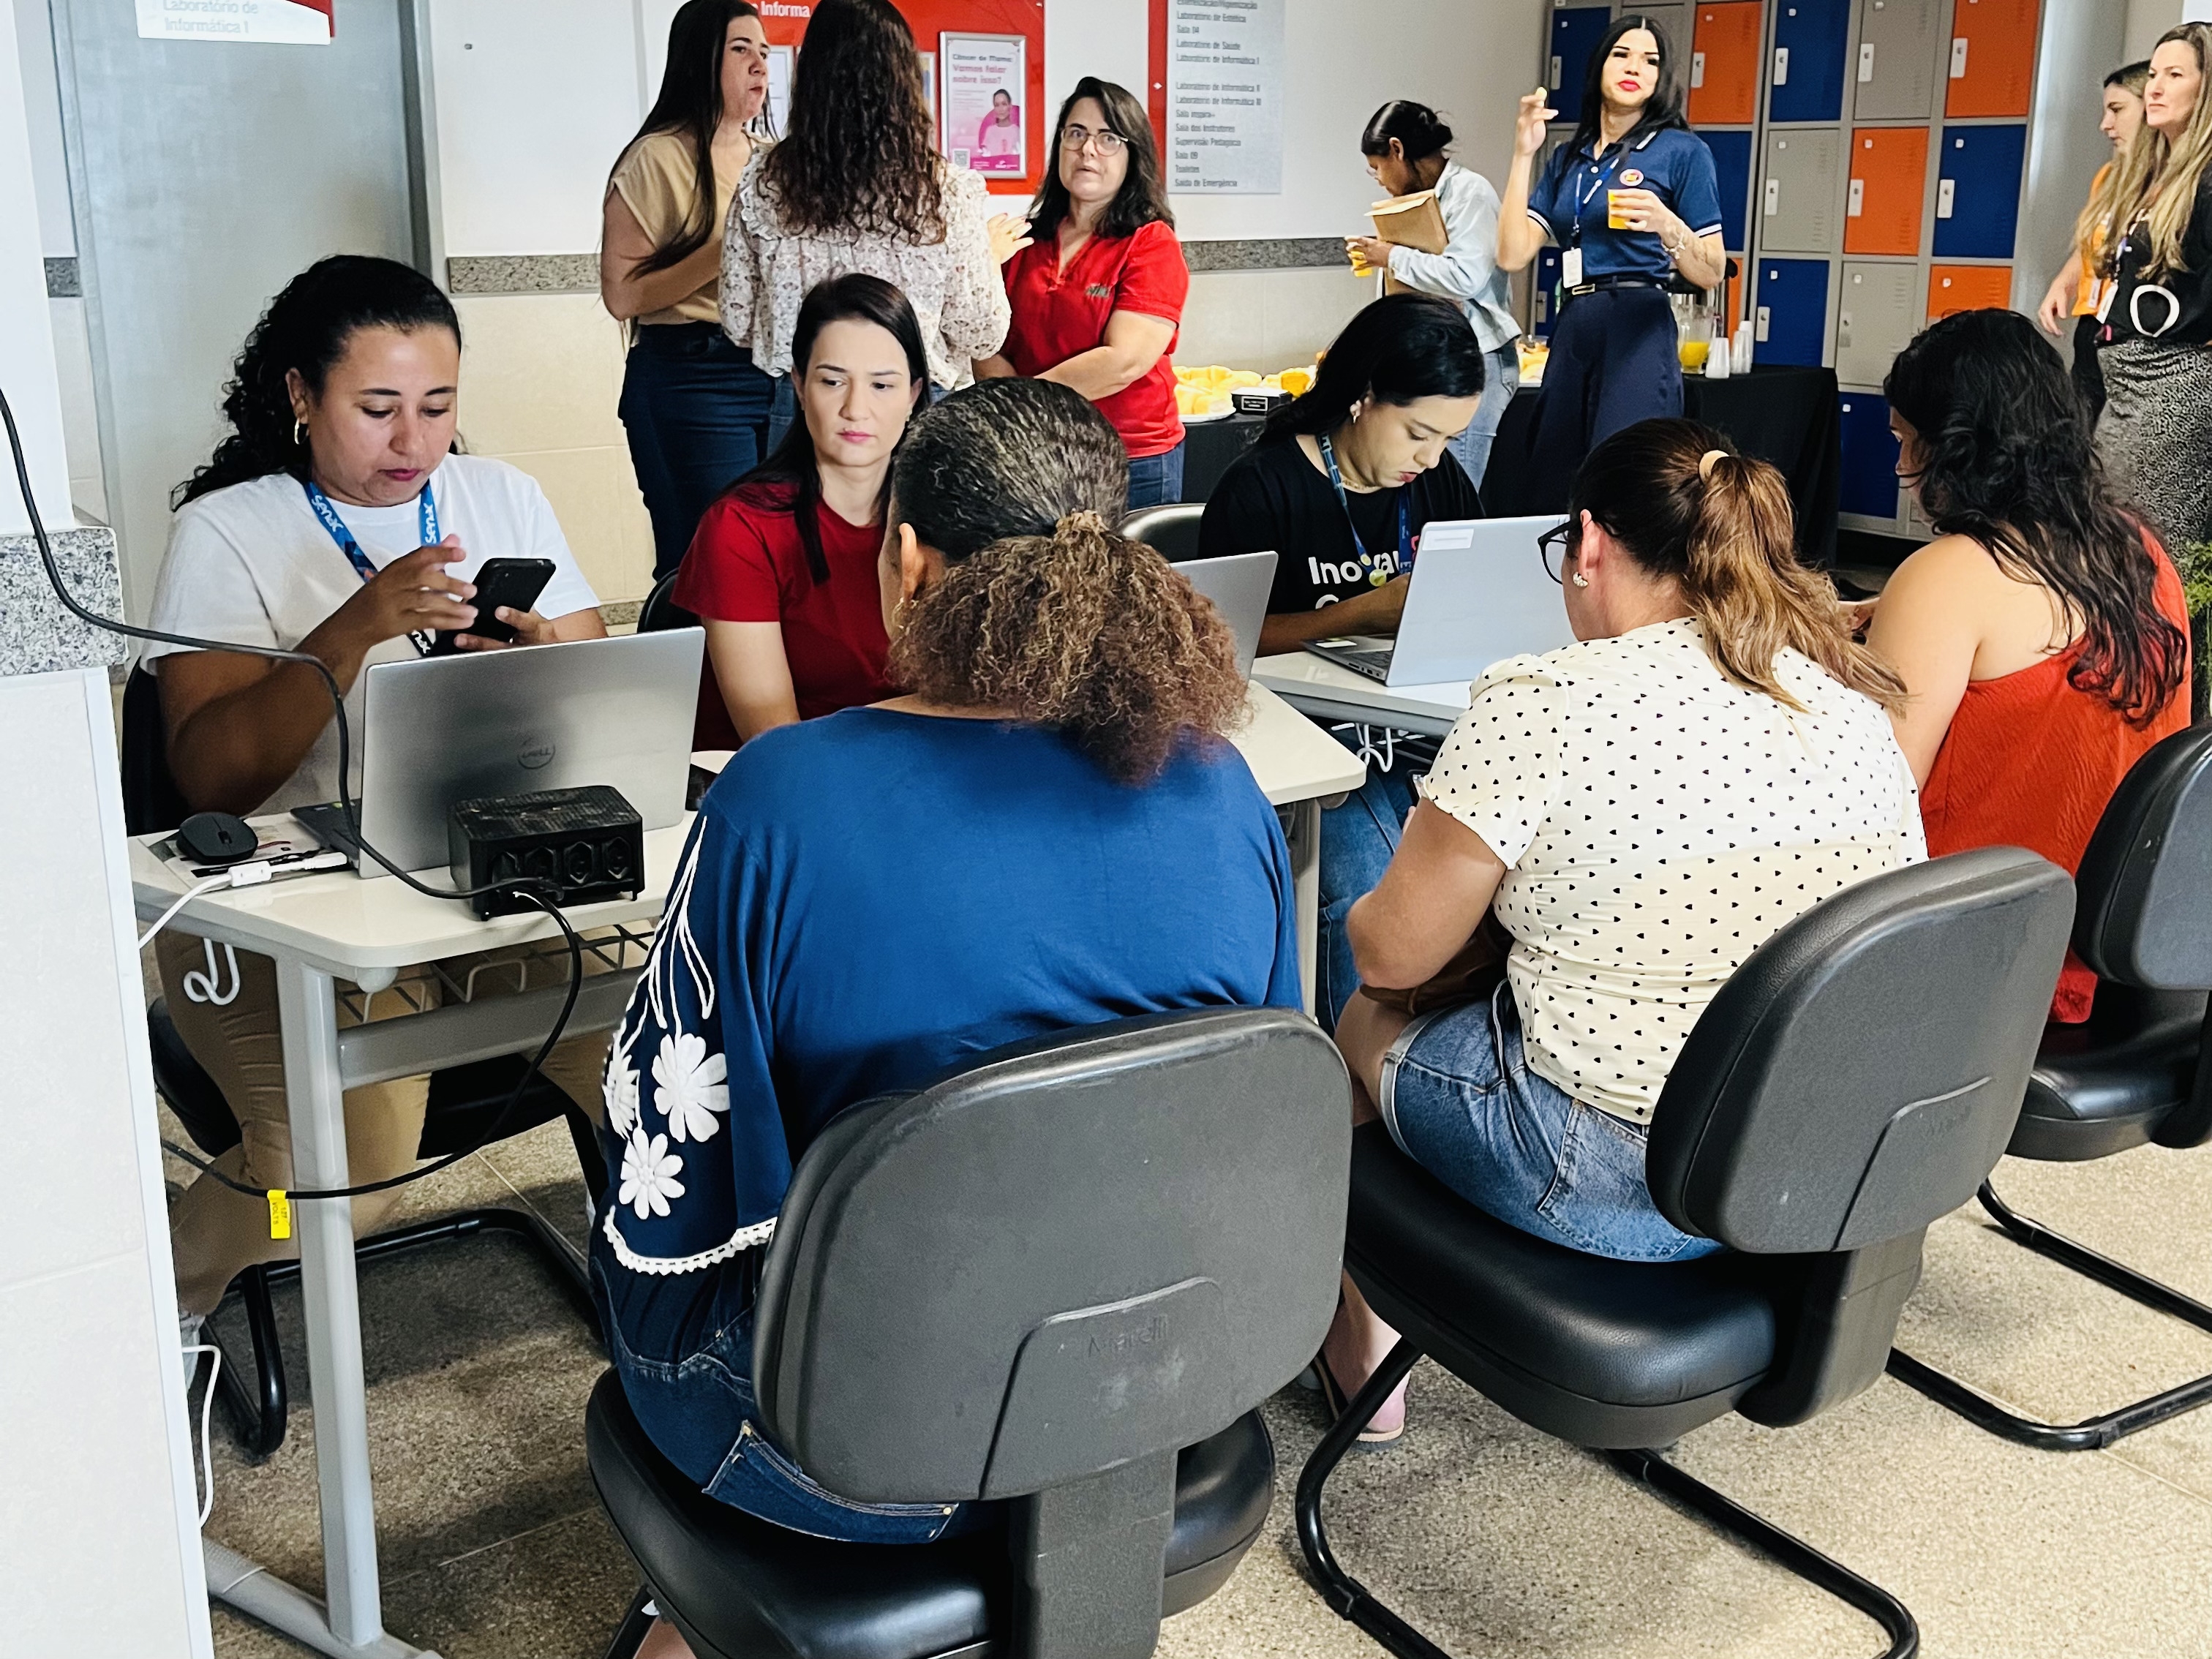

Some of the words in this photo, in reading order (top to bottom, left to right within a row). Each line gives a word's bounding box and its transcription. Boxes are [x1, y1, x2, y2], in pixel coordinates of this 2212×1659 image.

[242, 1, 258, 14] de
[761, 1, 810, 18] Informa
[165, 18, 241, 33] Informática
[952, 64, 983, 72] Vamos
[985, 65, 1007, 73] falar
[952, 75, 977, 83] sobre
[980, 75, 1001, 84] isso?
